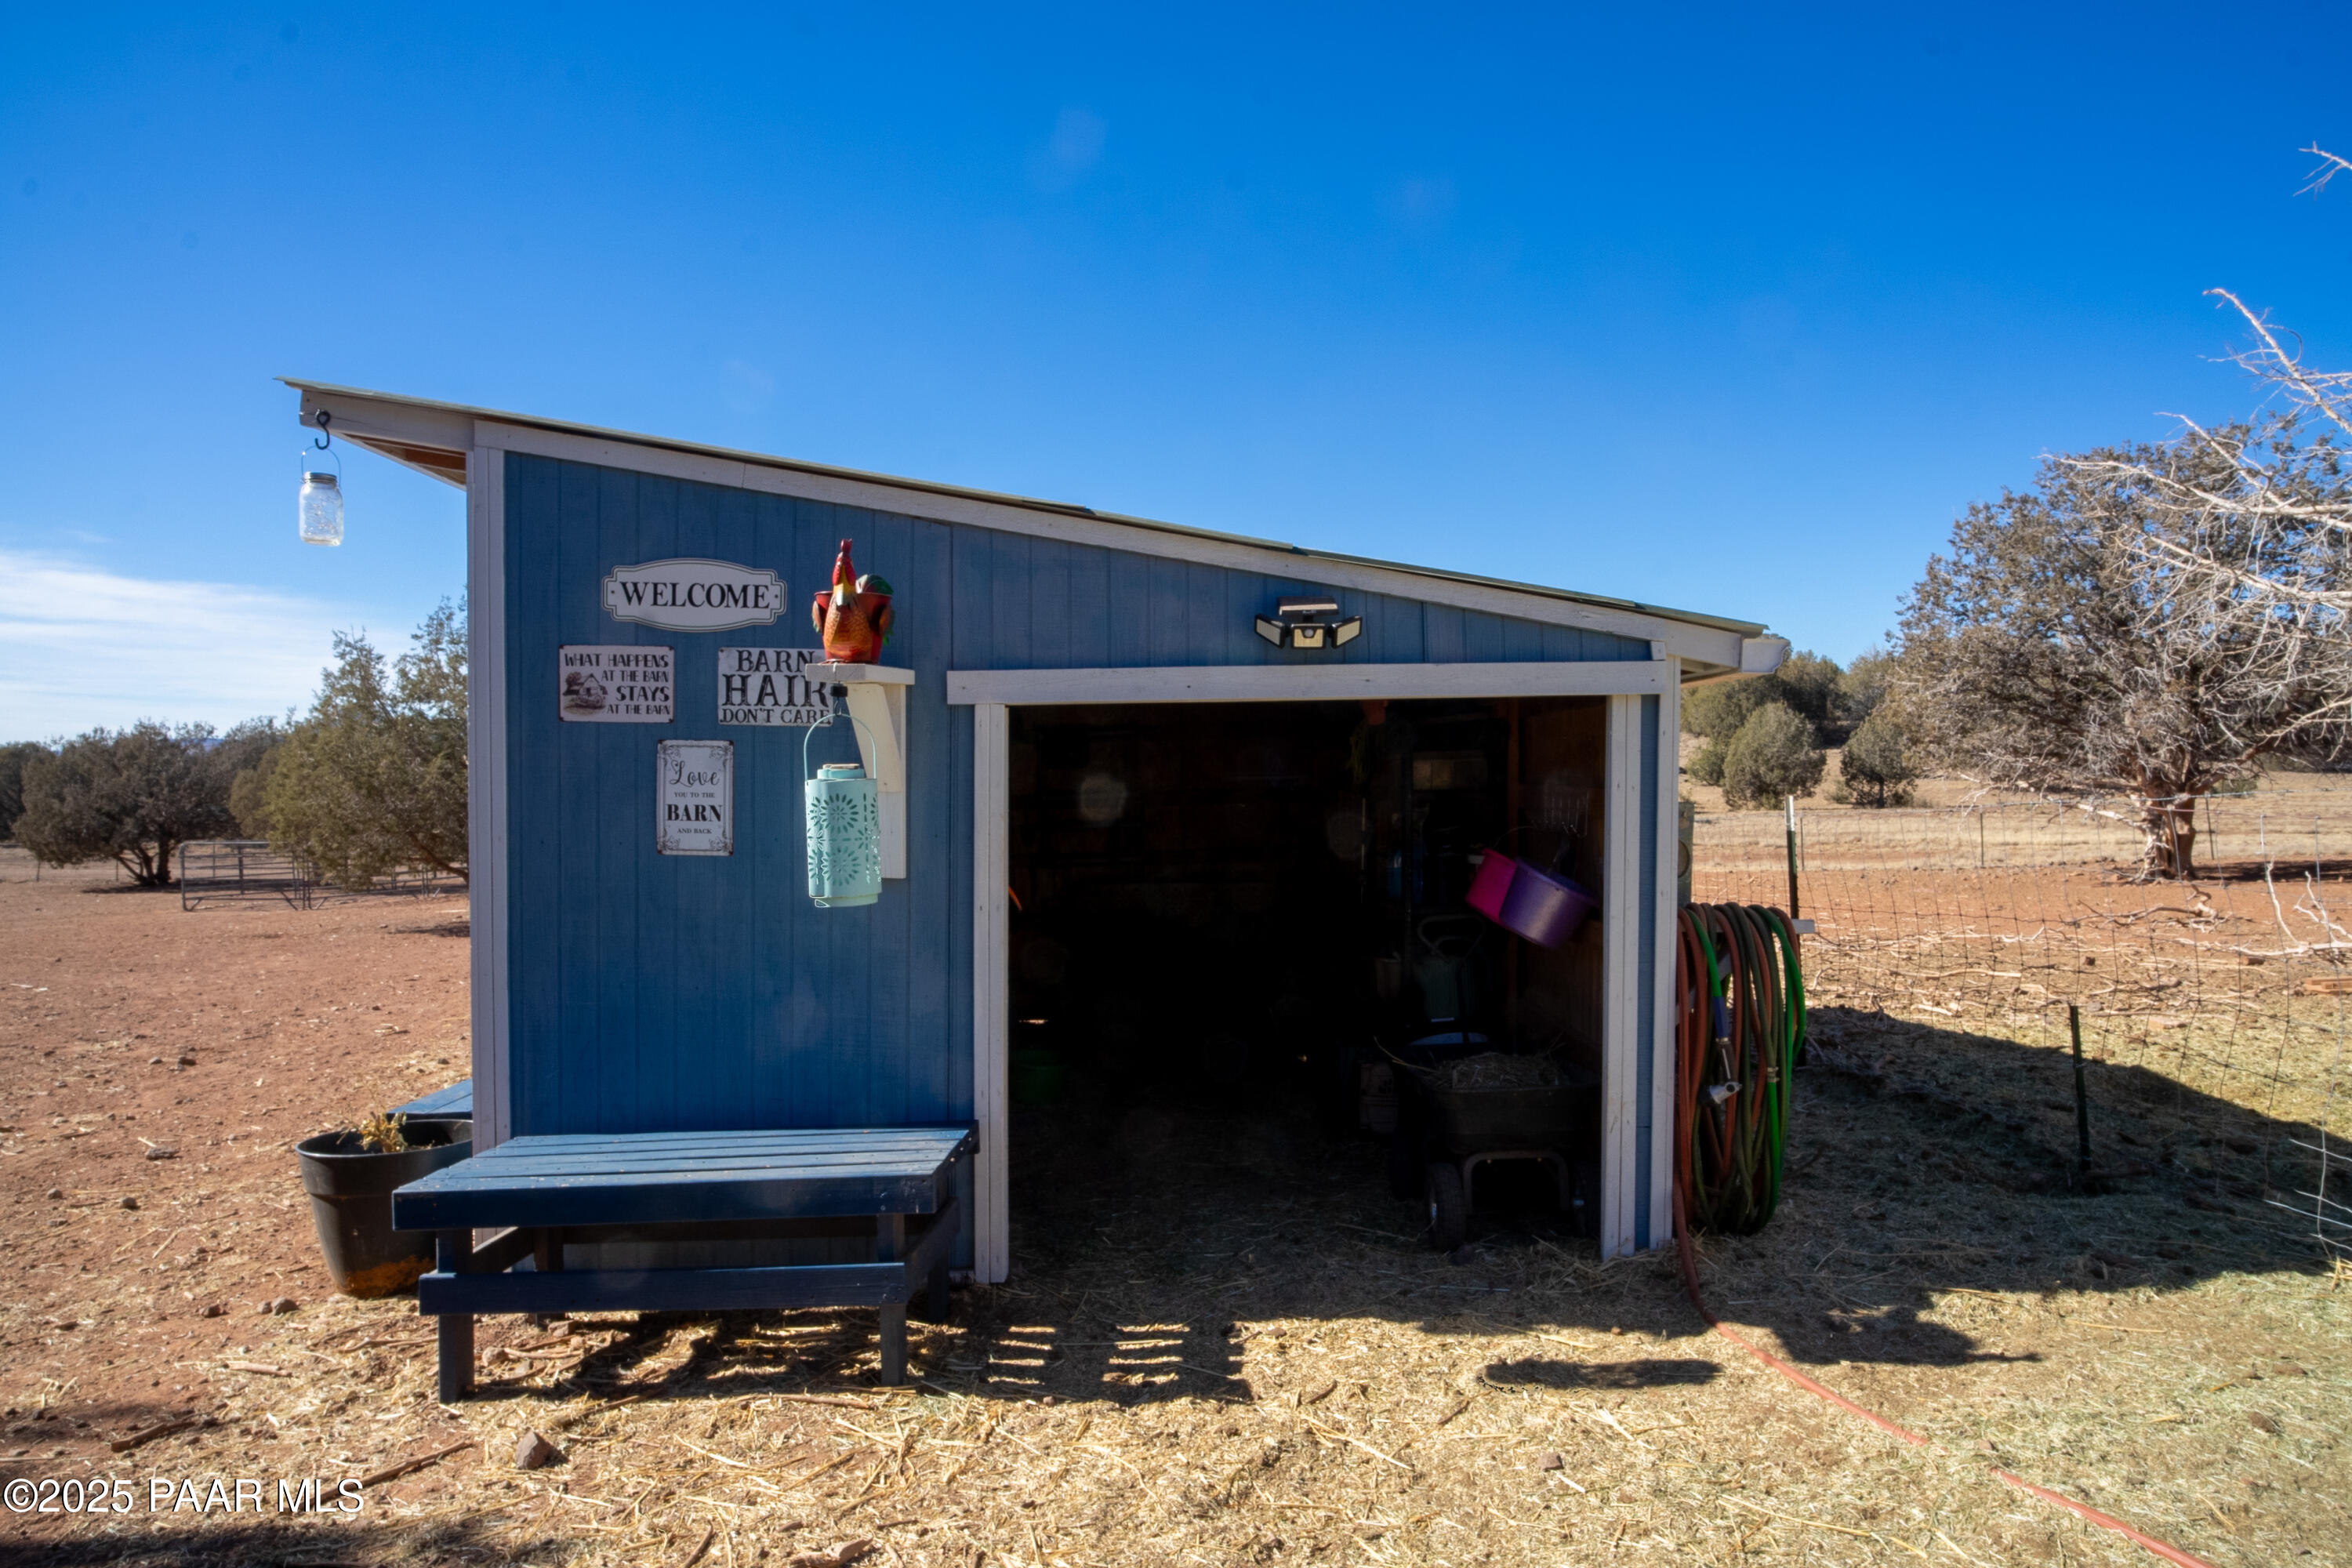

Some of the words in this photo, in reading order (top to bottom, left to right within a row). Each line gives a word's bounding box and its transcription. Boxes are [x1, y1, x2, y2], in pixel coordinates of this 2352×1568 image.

[620, 581, 770, 608] WELCOME
[564, 653, 601, 666] WHAT
[608, 654, 669, 667] HAPPENS
[735, 649, 815, 672] BARN
[601, 670, 615, 681] AT
[620, 670, 639, 681] THE
[643, 670, 669, 682] BARN
[616, 685, 670, 702] STAYS
[722, 674, 829, 707] HAIR
[608, 705, 619, 714] AT
[625, 705, 641, 714] THE
[646, 706, 670, 715] BARN
[720, 708, 774, 723] DON'T
[781, 709, 830, 724] CARE
[670, 760, 720, 787] Love
[666, 804, 723, 822] BARN
